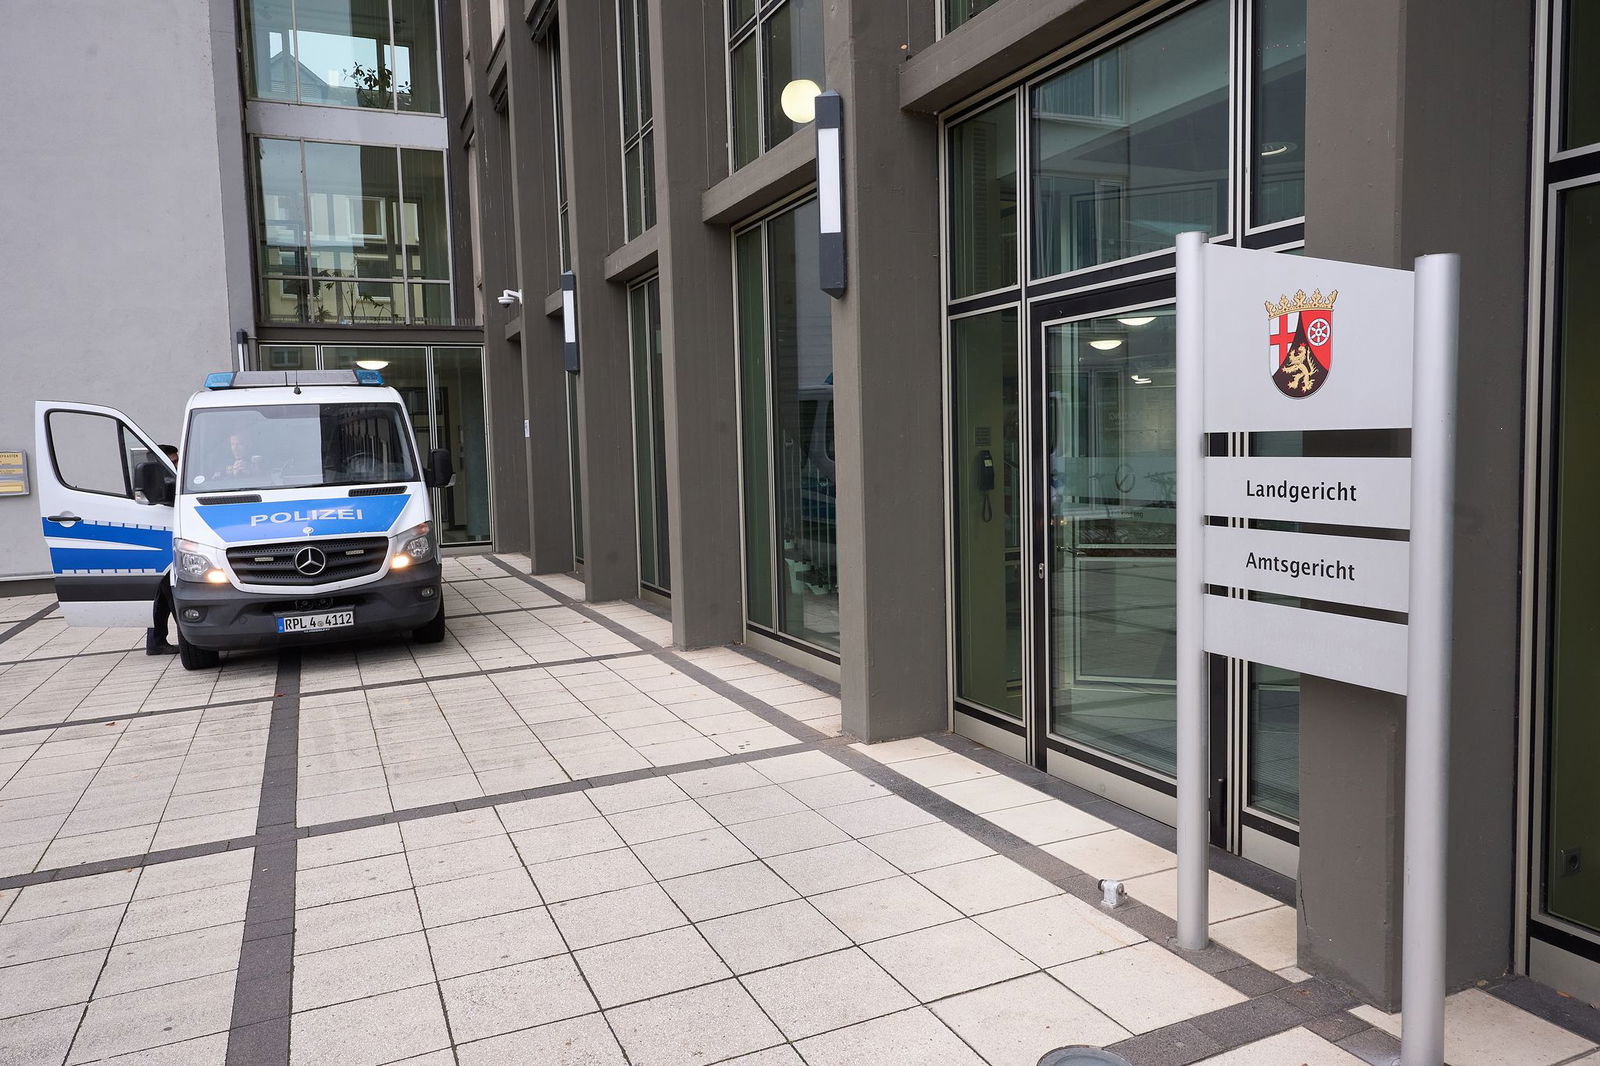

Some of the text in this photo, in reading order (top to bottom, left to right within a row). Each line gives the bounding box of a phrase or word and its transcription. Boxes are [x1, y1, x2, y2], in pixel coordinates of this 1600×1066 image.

[1246, 480, 1357, 503] Landgericht
[250, 509, 363, 527] POLIZEI
[1245, 552, 1355, 581] Amtsgericht
[285, 613, 352, 630] RPL 4 4112
